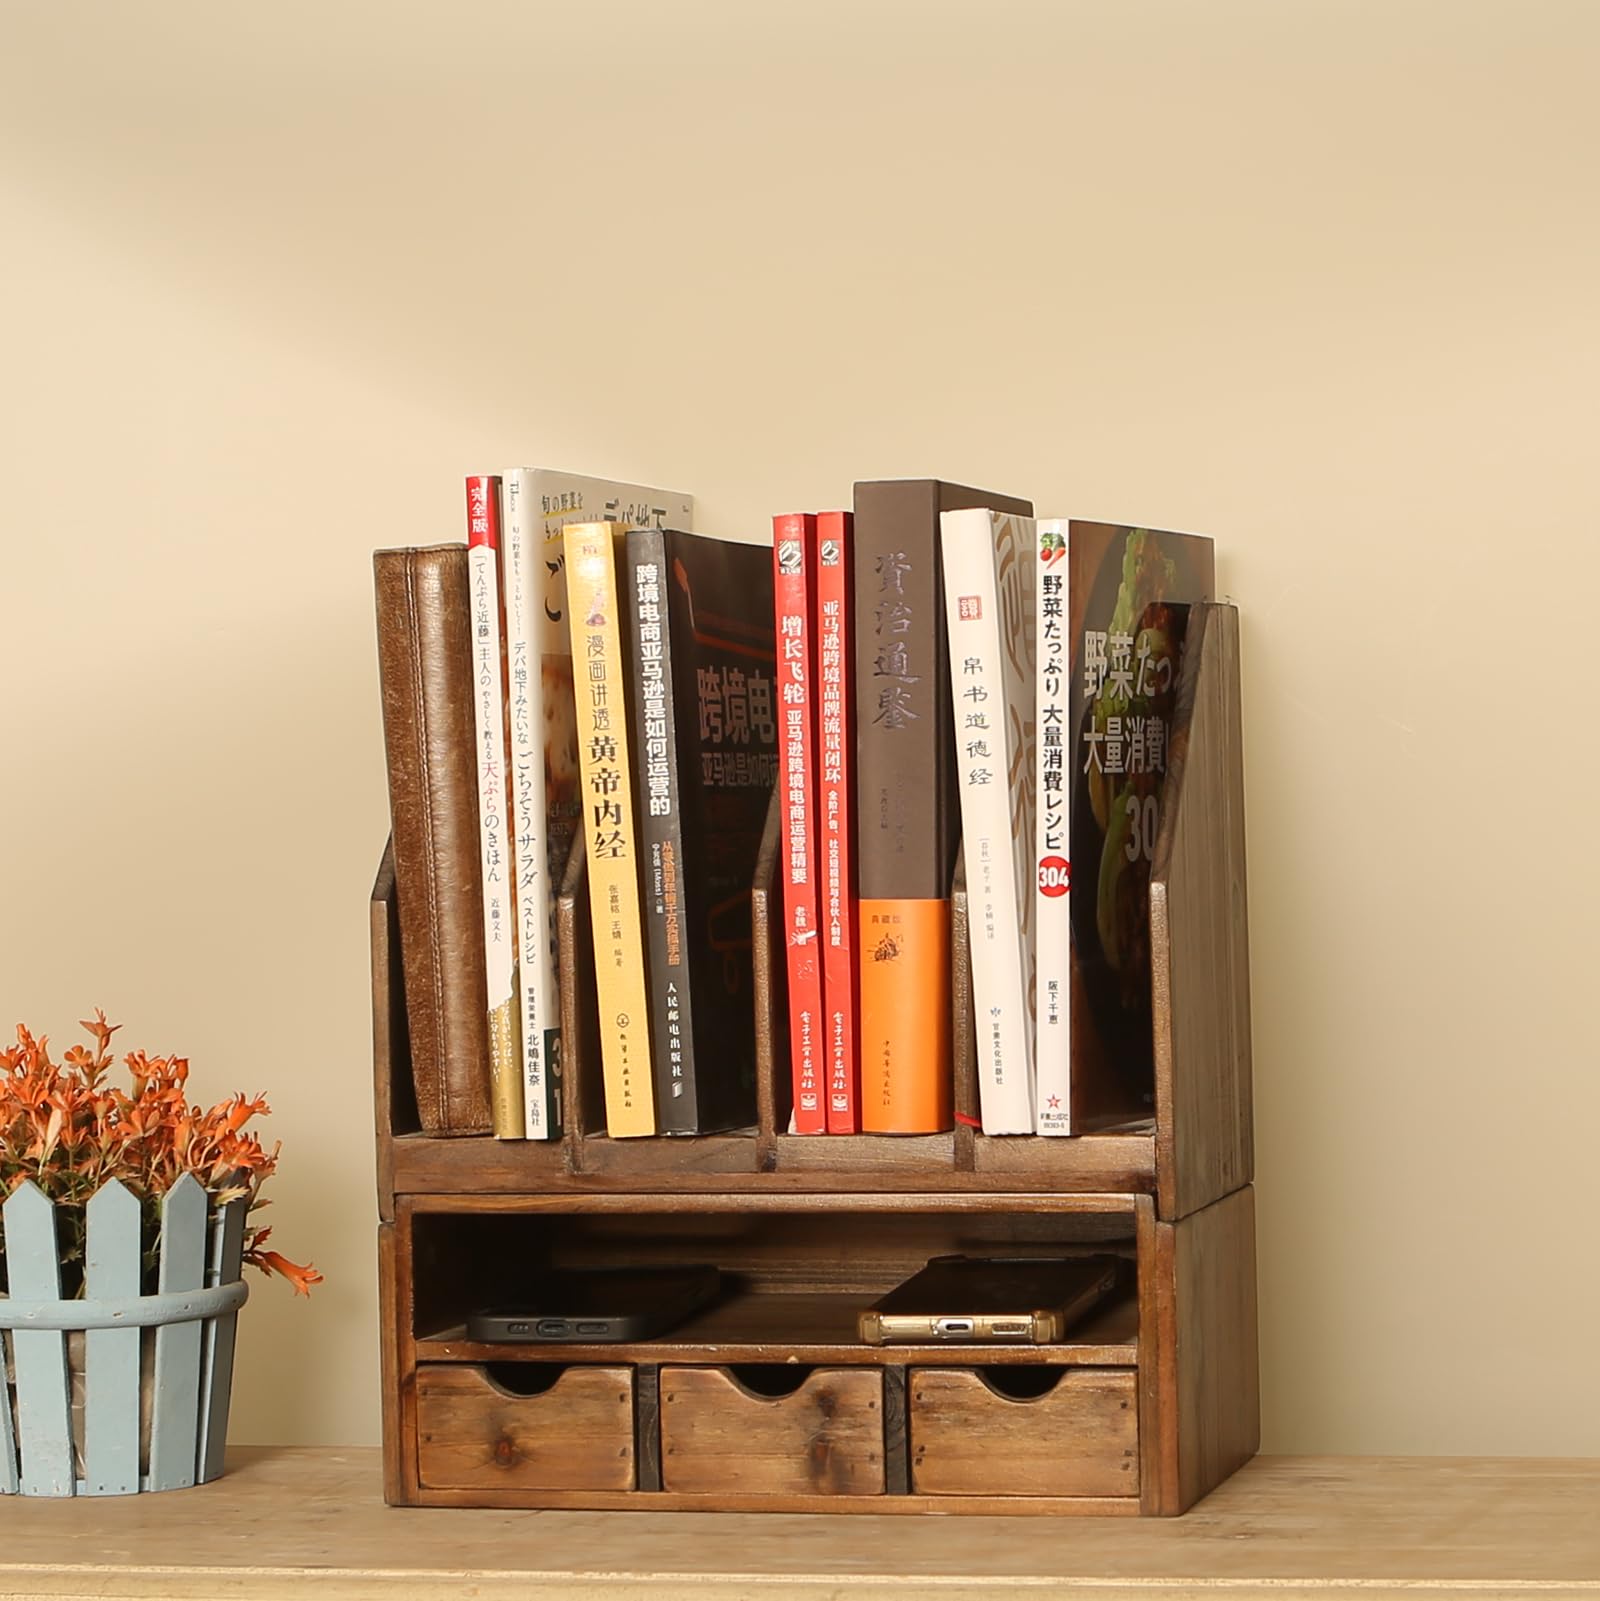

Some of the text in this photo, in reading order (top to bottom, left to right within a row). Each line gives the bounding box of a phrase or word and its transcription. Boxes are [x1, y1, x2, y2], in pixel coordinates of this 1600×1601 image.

[470, 486, 488, 533] 完全版
[513, 641, 529, 745] デパ地下みたいな
[635, 563, 671, 817] 跨境电商亚马逊是如何运营的
[781, 616, 805, 704] 增长飞轮
[822, 601, 842, 785] 亚马逊跨境品牌流量闭环
[586, 635, 627, 859] 漫画讲透 黄帝内经
[963, 656, 994, 786] 帛书道德经
[1039, 575, 1071, 888] 野菜たっぷり 大量消費レシピ 304
[482, 761, 502, 882] 天ぷらのきほん
[516, 751, 538, 888] ごちそうサラダ
[786, 710, 808, 884] 亚马逊跨境电商运营精要
[489, 897, 502, 942] 近藤文夫
[521, 896, 536, 965] ベストレシピ
[666, 981, 683, 1078] 人民邮电出版社
[1047, 980, 1059, 1025] 阪下千恵
